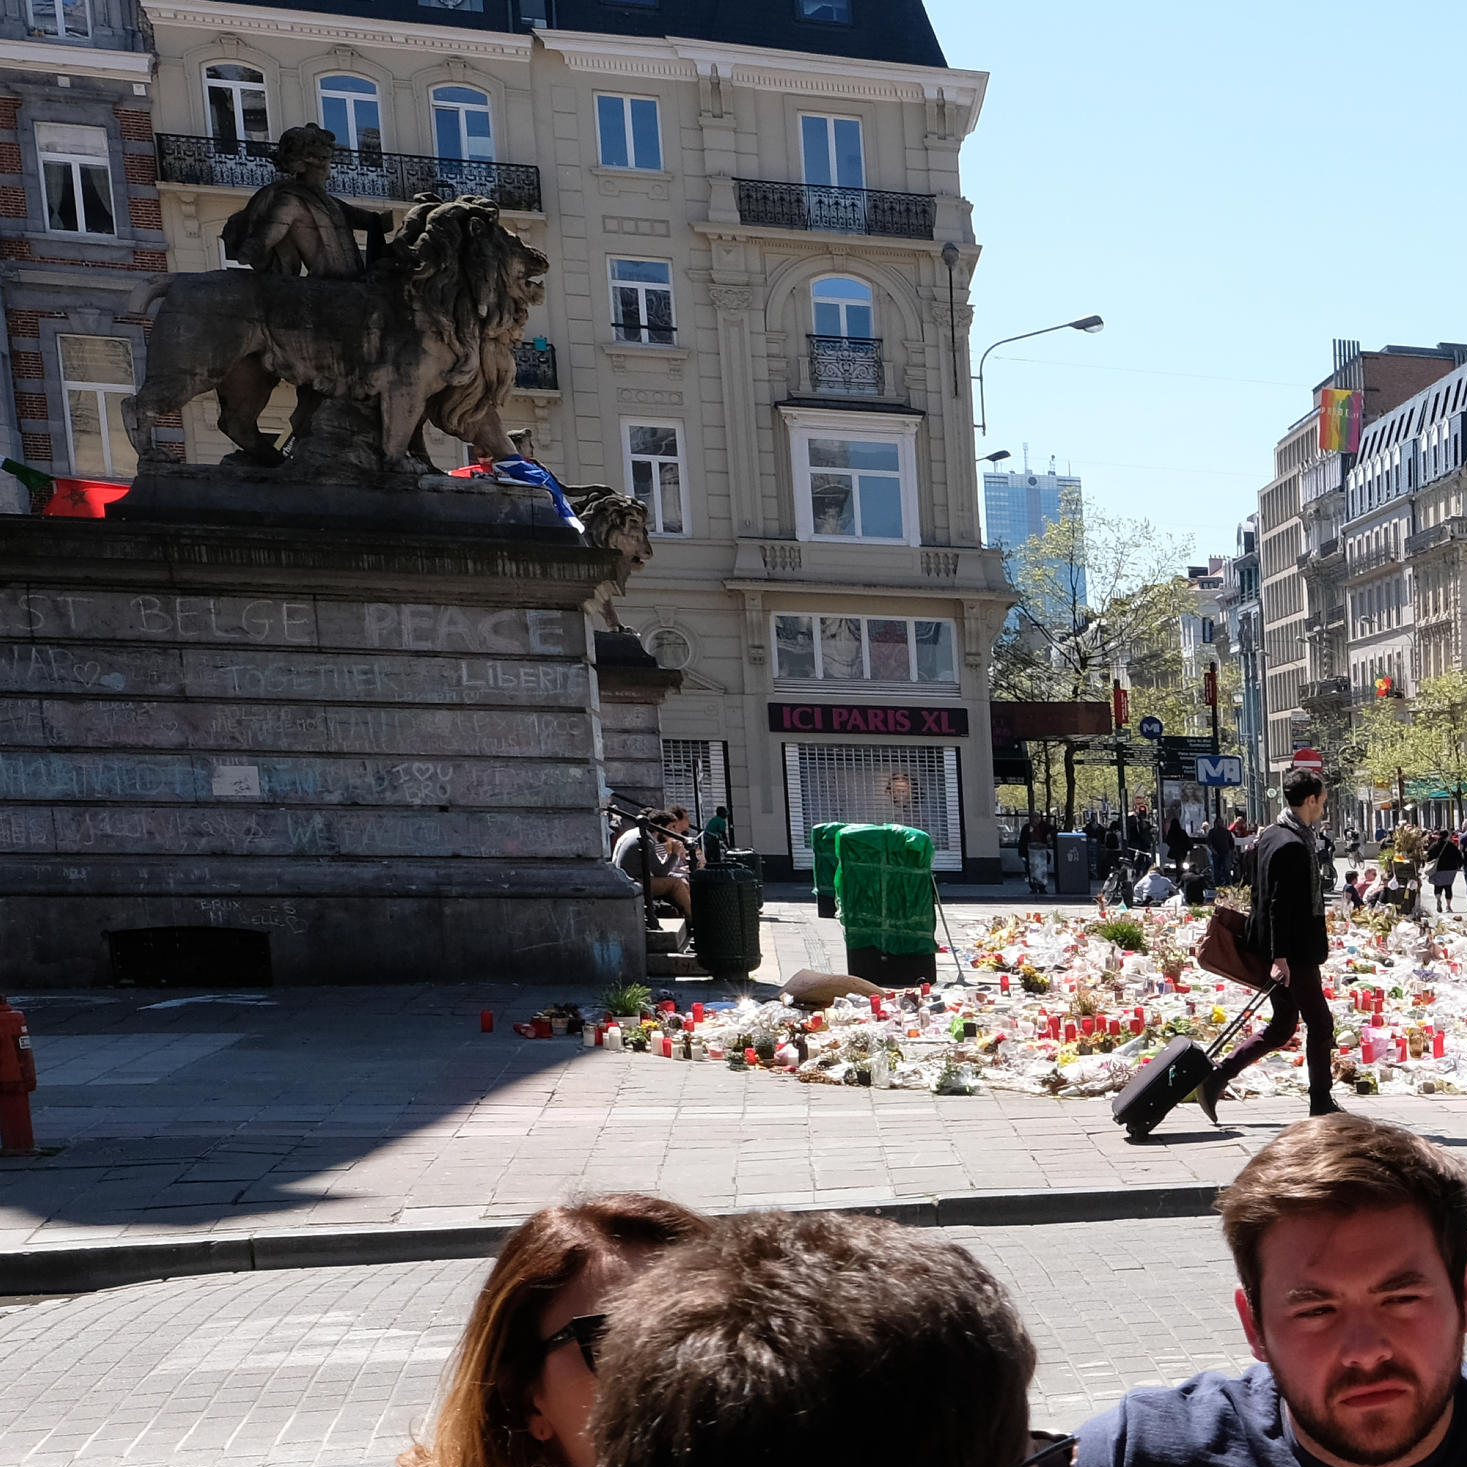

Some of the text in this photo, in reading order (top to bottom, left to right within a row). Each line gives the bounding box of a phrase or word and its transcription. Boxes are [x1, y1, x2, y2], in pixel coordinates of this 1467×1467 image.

[129, 595, 311, 644] BELGE
[364, 602, 565, 656] PEACE
[783, 706, 956, 733] ICI PARIS XL
